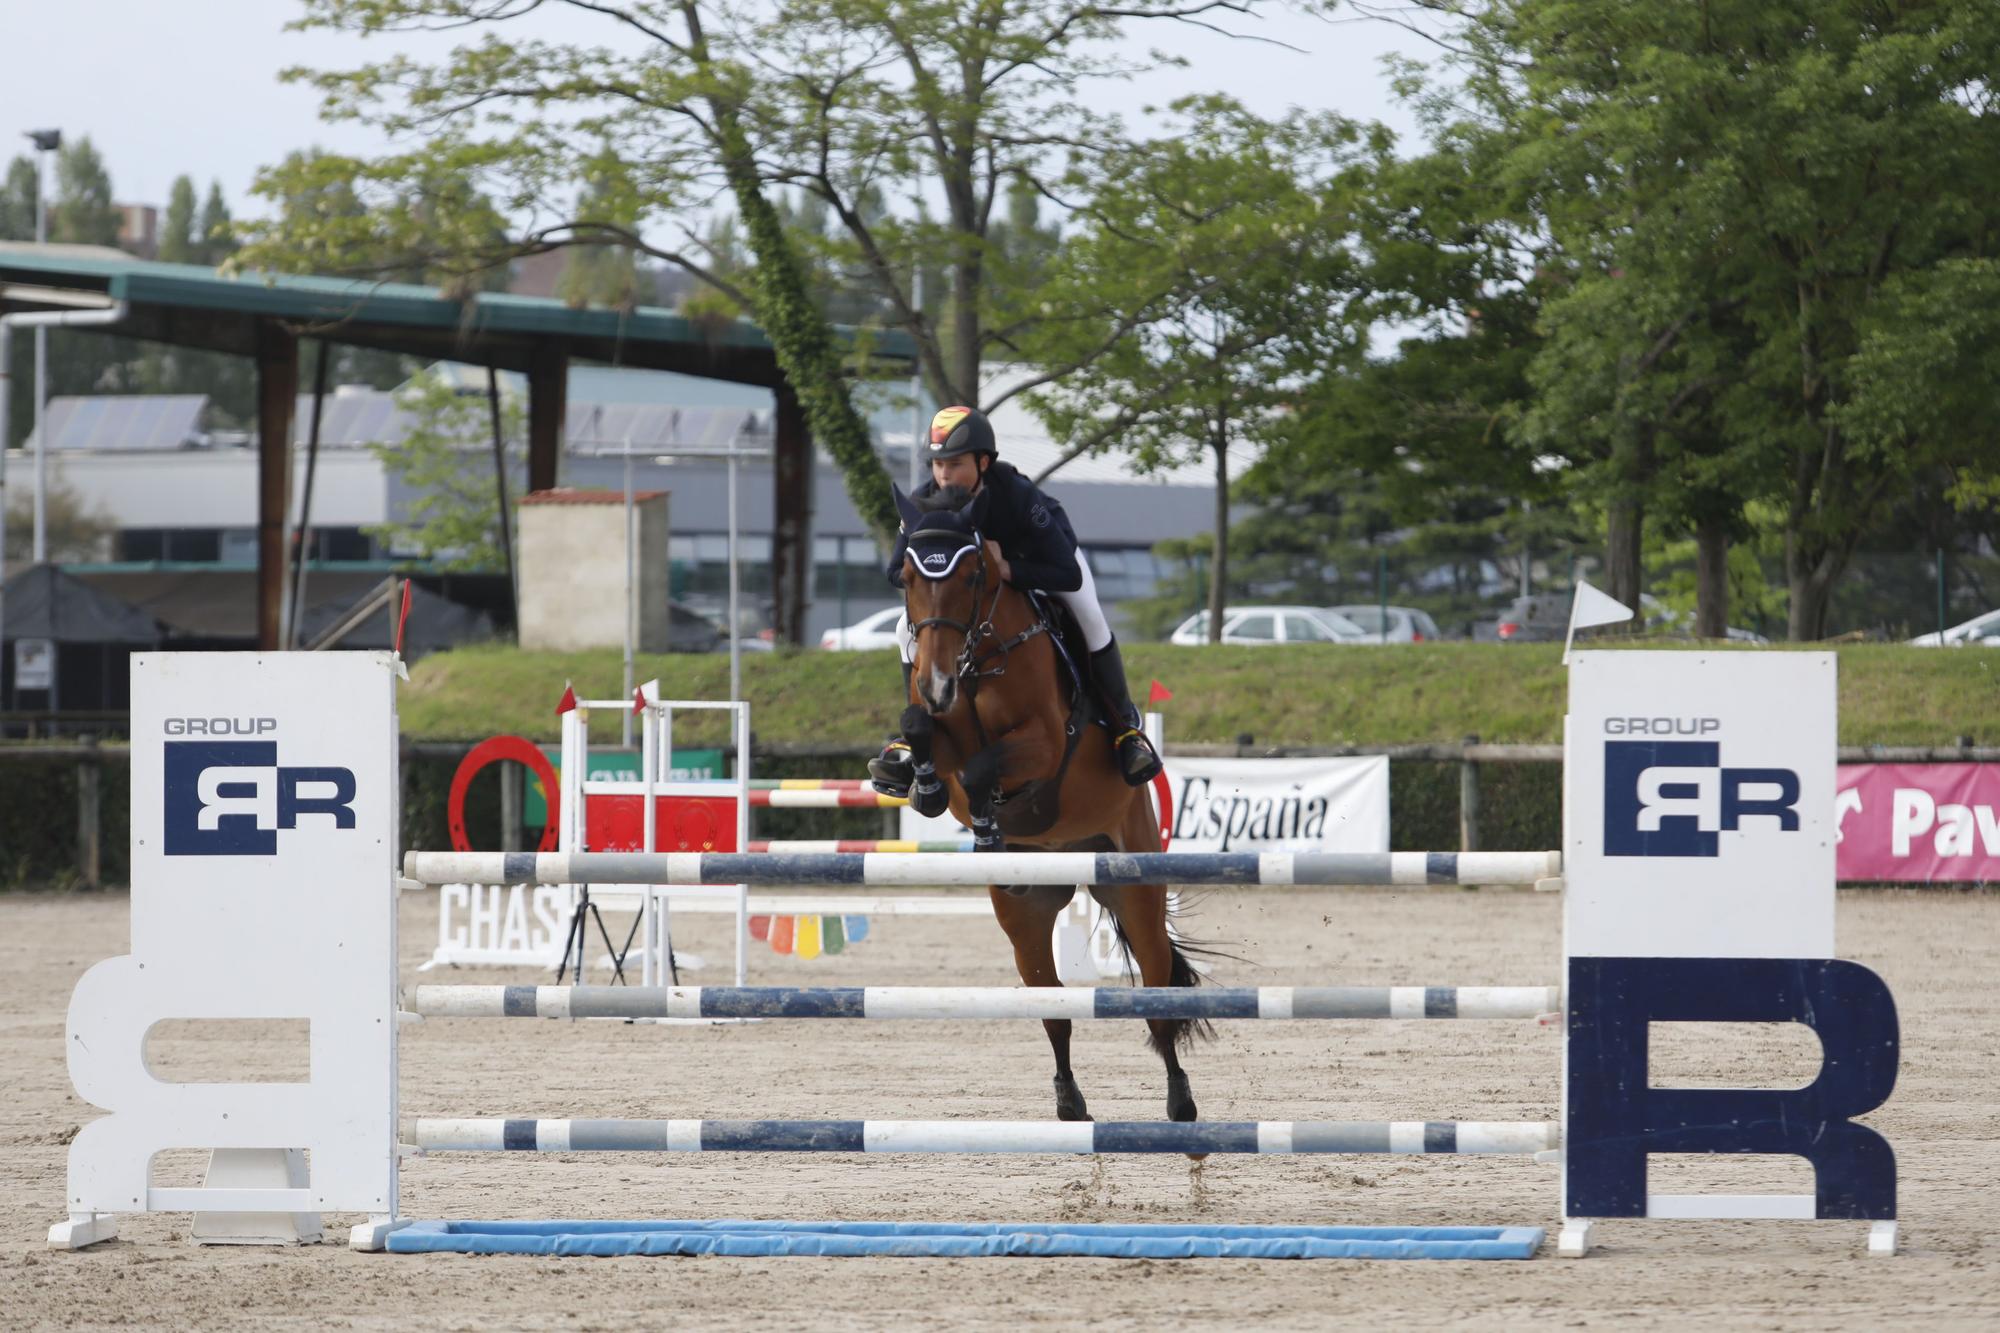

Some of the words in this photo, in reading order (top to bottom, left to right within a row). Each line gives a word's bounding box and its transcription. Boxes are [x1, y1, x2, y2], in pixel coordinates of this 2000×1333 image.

[164, 717, 277, 735] GROUP
[1604, 717, 1720, 735] GROUP
[1171, 776, 1328, 852] España
